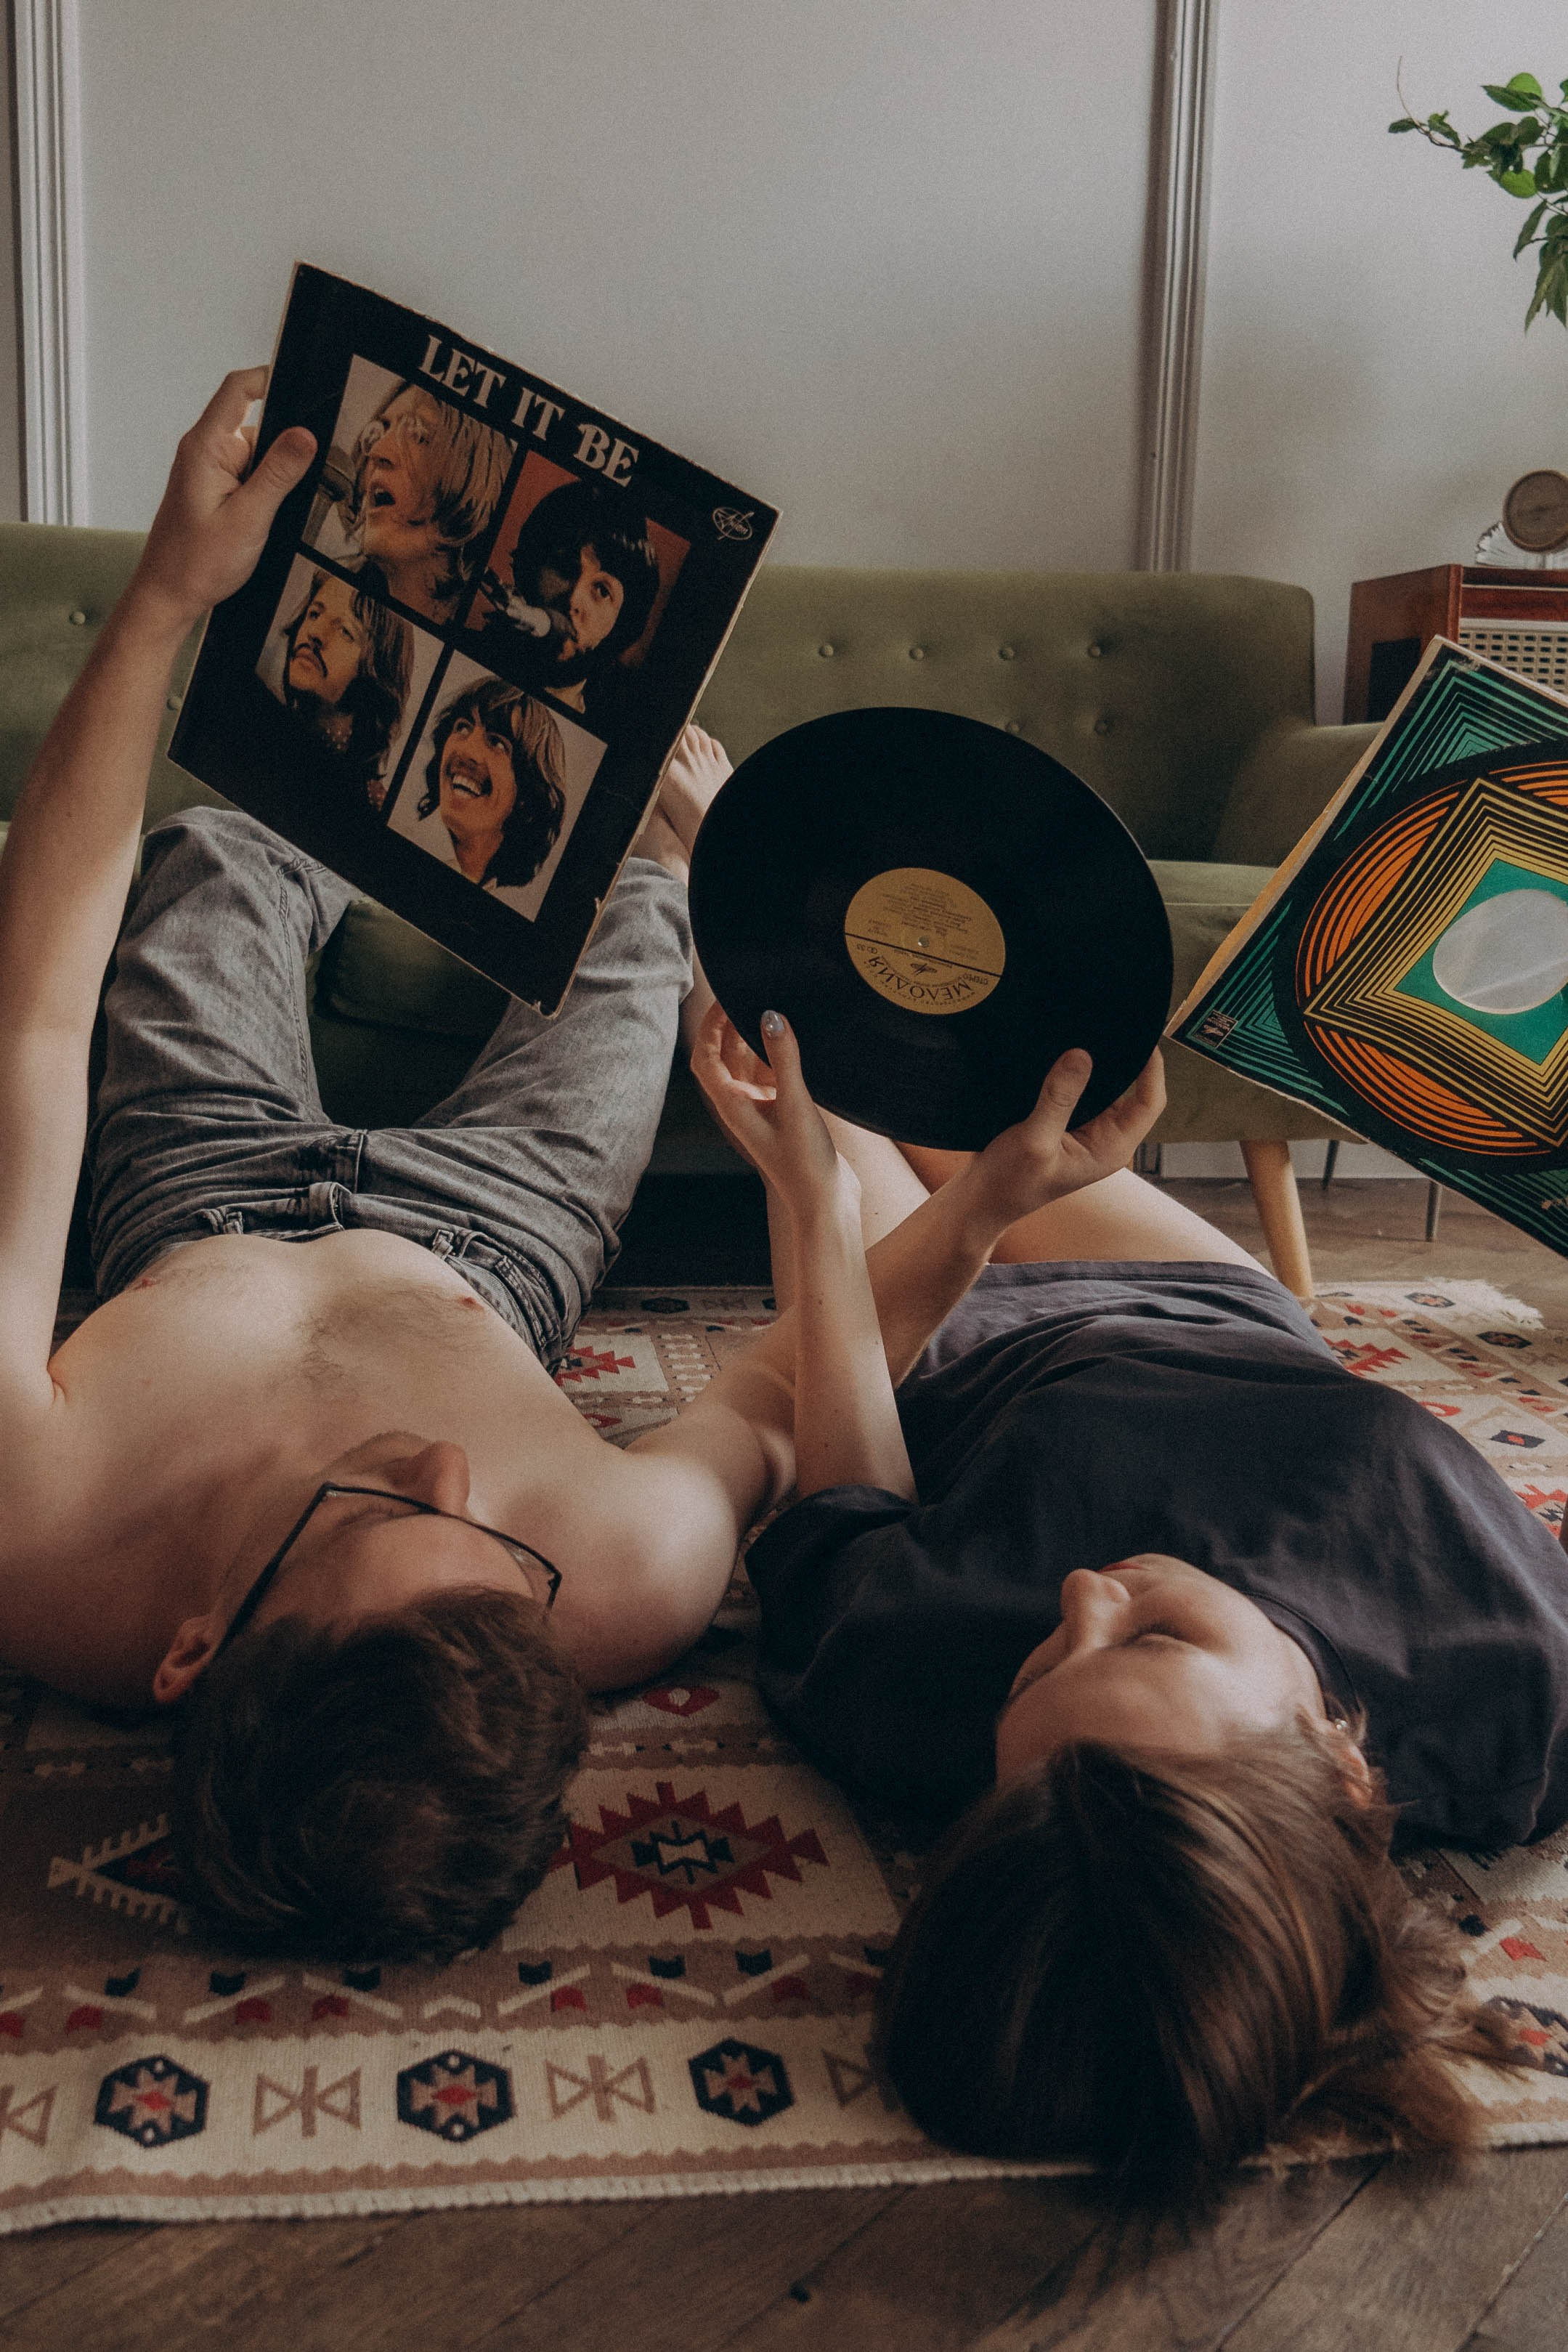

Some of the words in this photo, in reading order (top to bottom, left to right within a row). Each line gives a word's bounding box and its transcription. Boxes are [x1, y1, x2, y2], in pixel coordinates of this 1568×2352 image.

[418, 334, 507, 408] LET
[511, 386, 566, 441] IT
[573, 423, 640, 488] BE
[869, 956, 974, 1001] МЕЛОДИЯ
[962, 973, 988, 986] СТЕРЕО
